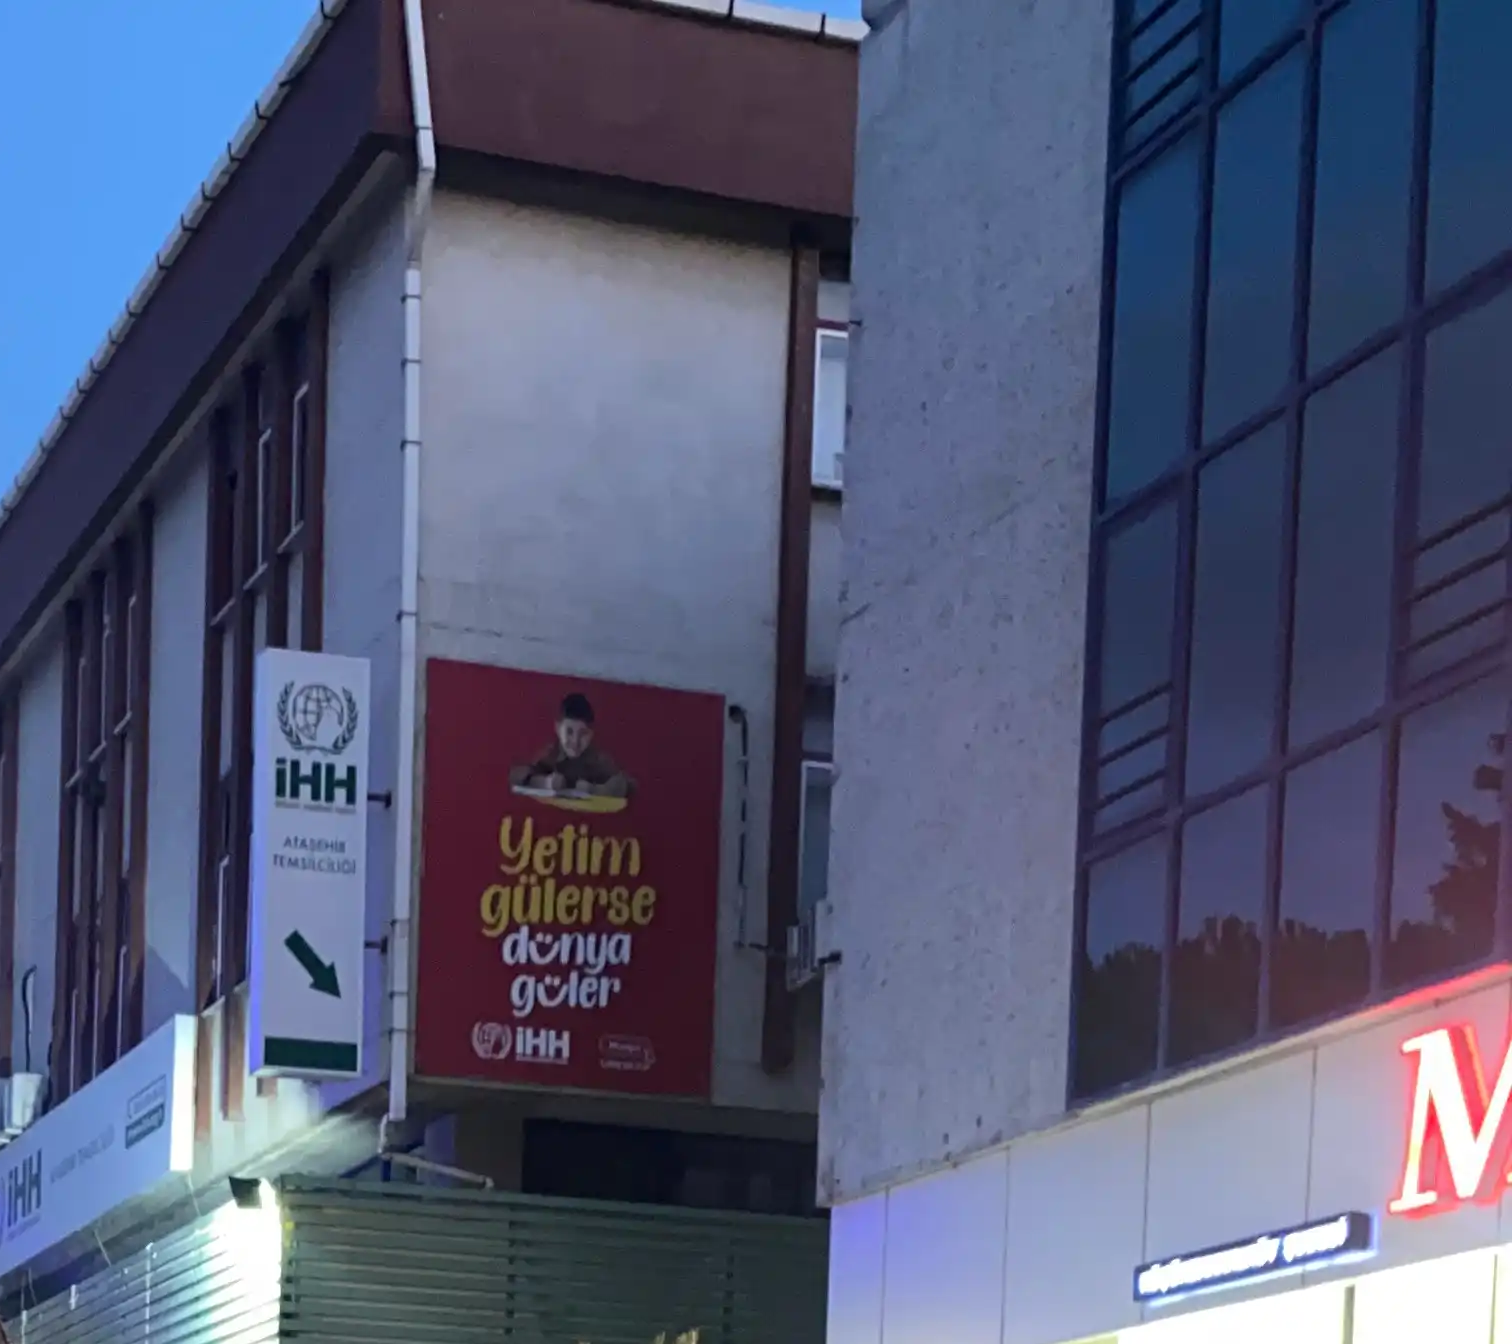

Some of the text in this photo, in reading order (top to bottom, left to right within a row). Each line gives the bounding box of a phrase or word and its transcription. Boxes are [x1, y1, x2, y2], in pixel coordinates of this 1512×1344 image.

[499, 816, 640, 876] Yetim
[480, 873, 656, 937] gülerse
[502, 924, 632, 975] dünya
[510, 969, 621, 1017] güler
